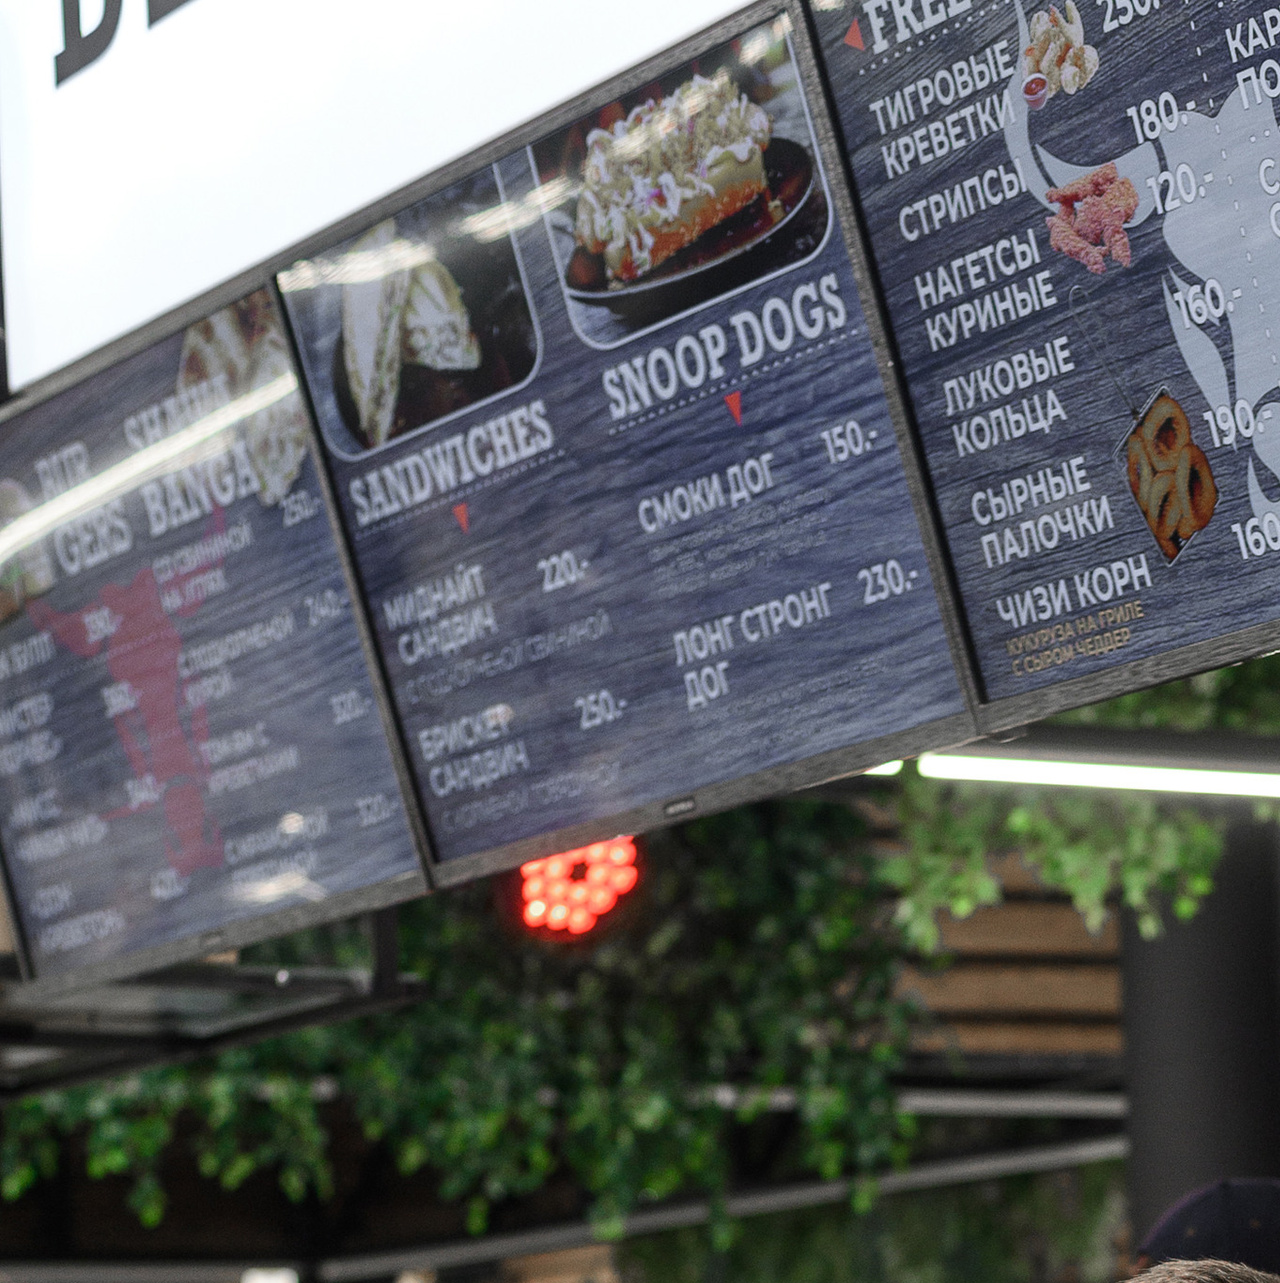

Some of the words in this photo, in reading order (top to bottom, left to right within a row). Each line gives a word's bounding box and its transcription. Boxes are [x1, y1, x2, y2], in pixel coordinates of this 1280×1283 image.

[869, 39, 1016, 136] ТИГРОВЫЕ
[881, 89, 1017, 180] КРЕВЕТКИ
[898, 158, 1028, 242] СТРИПСЫ
[914, 228, 1041, 310] НАГЕТСЫ
[602, 323, 727, 421] SNOOP
[729, 272, 848, 368] DOGS
[924, 269, 1059, 352] КУРИНЫЕ
[943, 336, 1076, 417] ЛУКОВЫЕ
[349, 399, 555, 528] SANDWICHES
[953, 389, 1068, 459] КОЛЬЦА
[638, 472, 727, 534] СМОКИ
[726, 452, 776, 508] ДОГ
[971, 456, 1092, 528] СЫРНЫЕ
[981, 495, 1114, 569] ПАЛОЧКИ
[673, 614, 735, 667] ЛОНГ
[739, 581, 832, 643] СТРОНГ
[996, 578, 1072, 629] ЧИЗИ
[1073, 553, 1153, 608] КОРН
[1075, 615, 1099, 635] НА
[1098, 600, 1145, 628] ГРИЛЕ
[397, 602, 500, 667] САНДВИЧ
[1023, 645, 1076, 674] СЫРОМ
[683, 661, 730, 712] ДОГ
